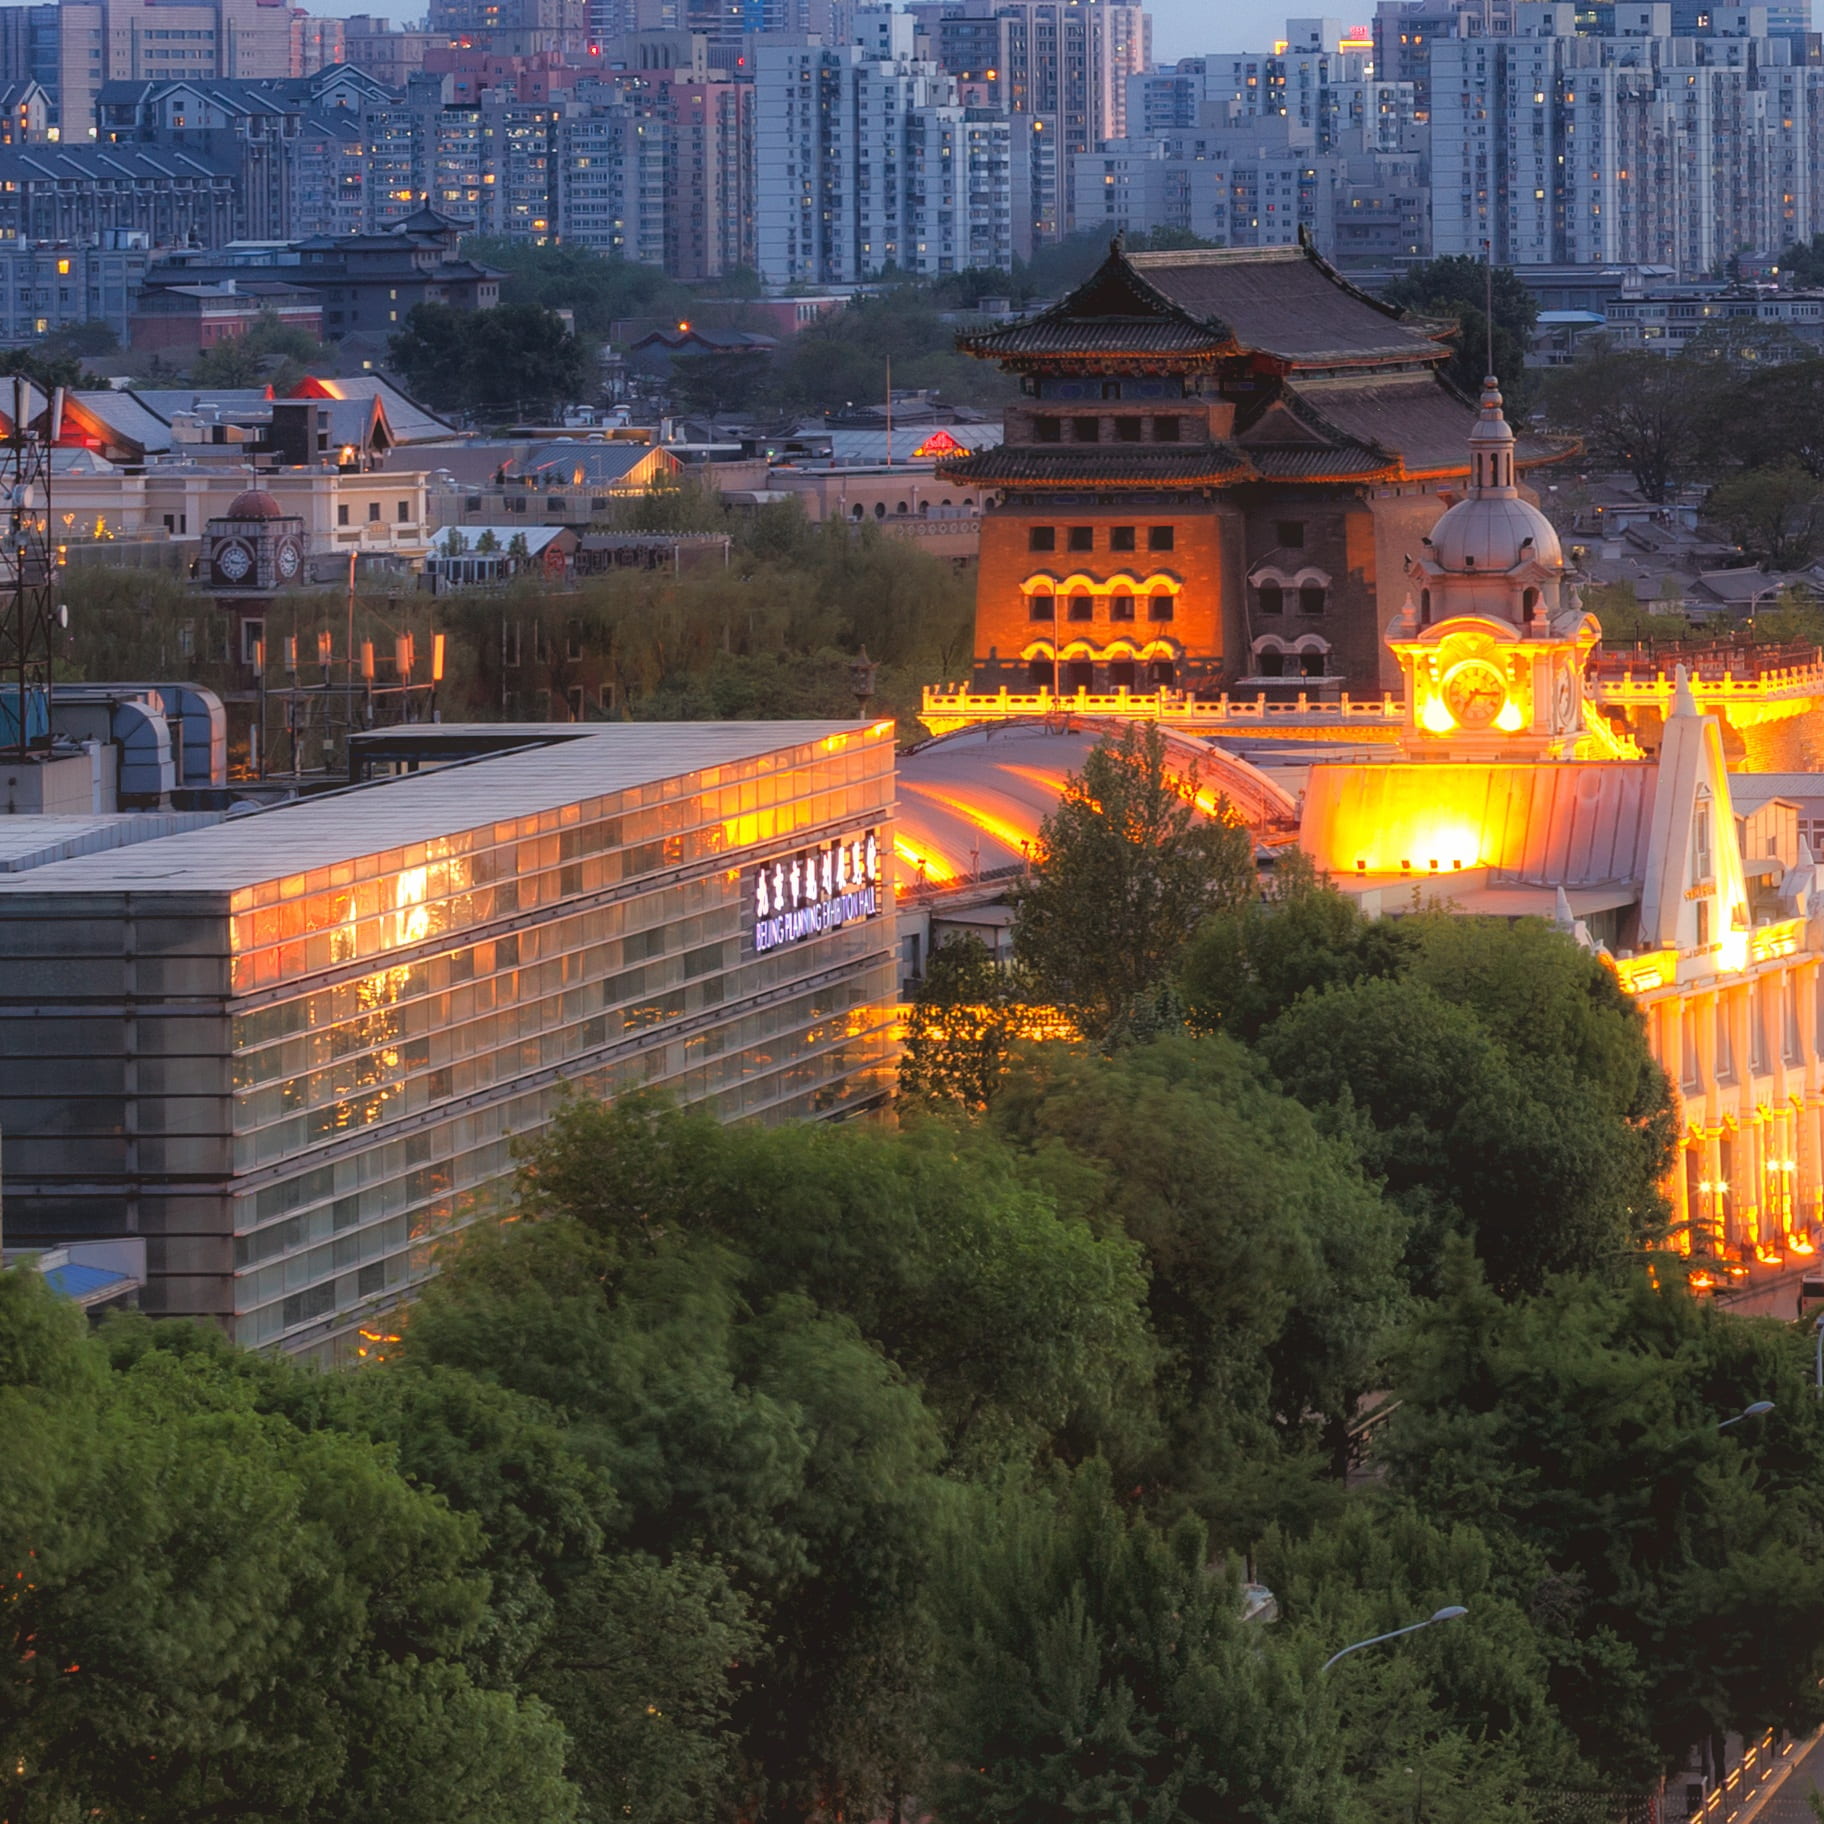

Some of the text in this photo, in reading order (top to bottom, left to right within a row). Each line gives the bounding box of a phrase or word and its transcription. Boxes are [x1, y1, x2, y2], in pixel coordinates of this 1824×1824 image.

[756, 884, 876, 952] BEIJING PLANNING EXHIBITION HALL
